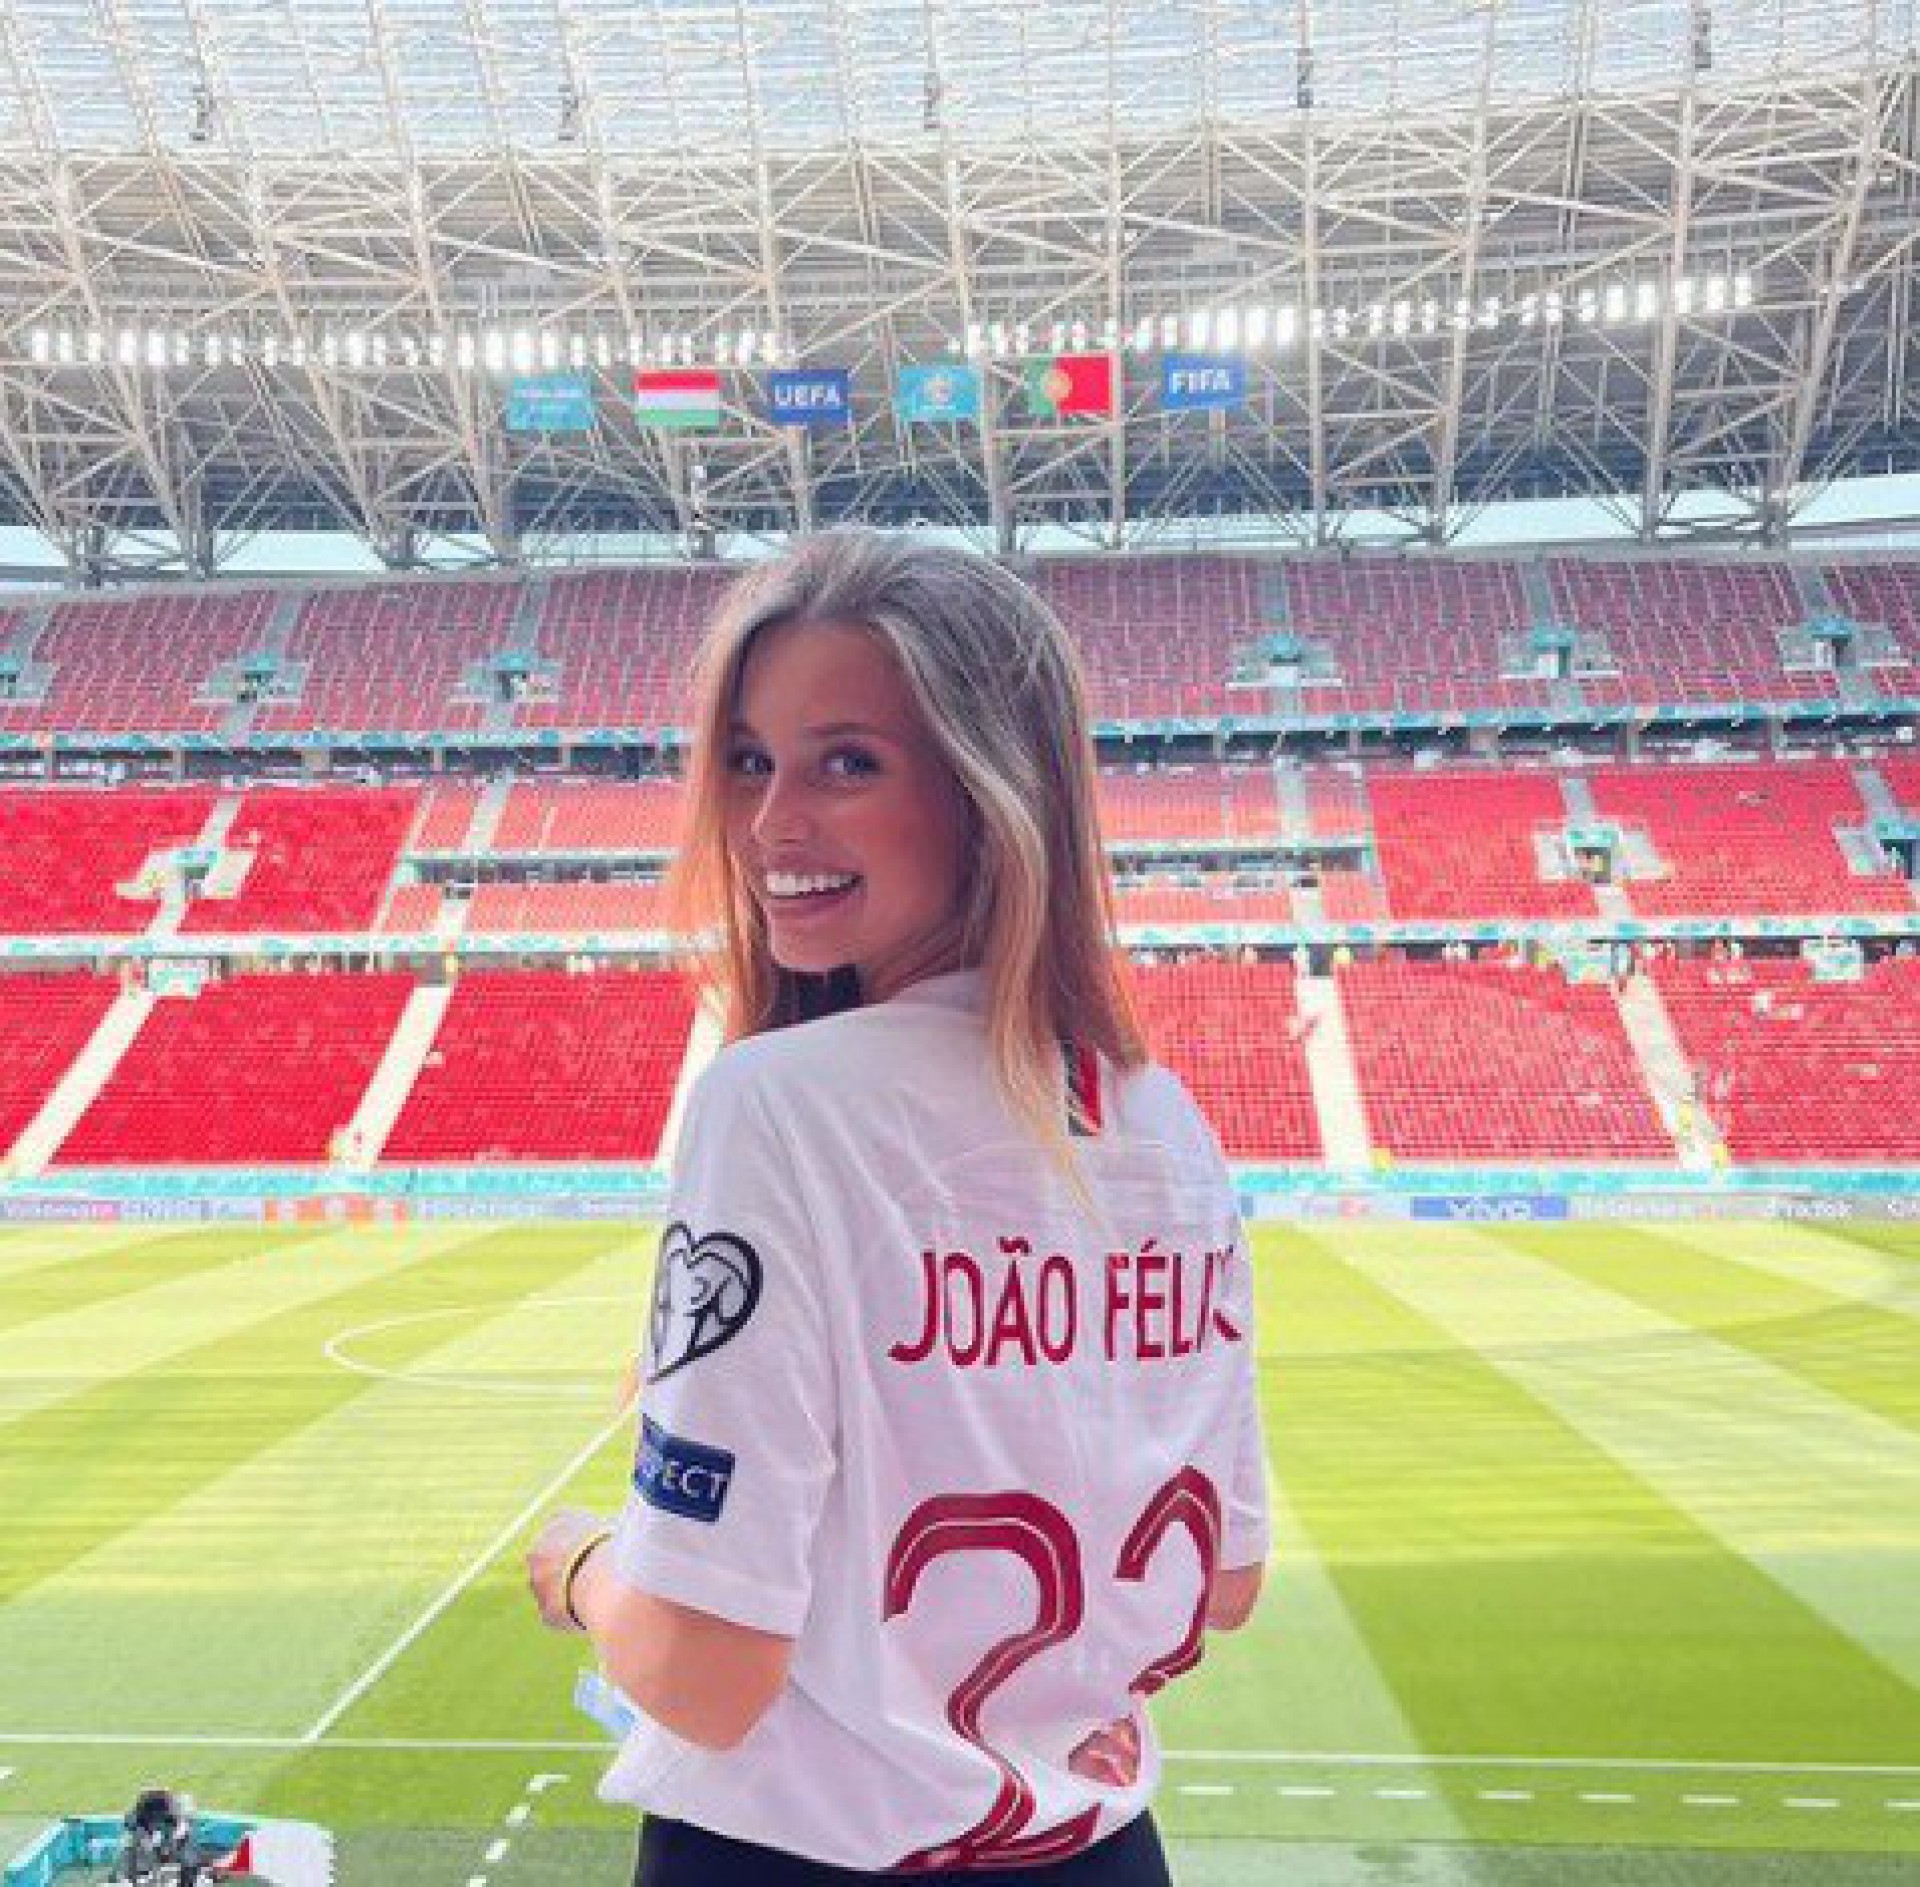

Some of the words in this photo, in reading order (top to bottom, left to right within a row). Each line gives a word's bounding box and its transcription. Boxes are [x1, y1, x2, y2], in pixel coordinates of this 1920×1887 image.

[774, 383, 842, 407] UEFA
[1170, 368, 1230, 395] FIFA
[887, 1236, 1077, 1365] JOÃO
